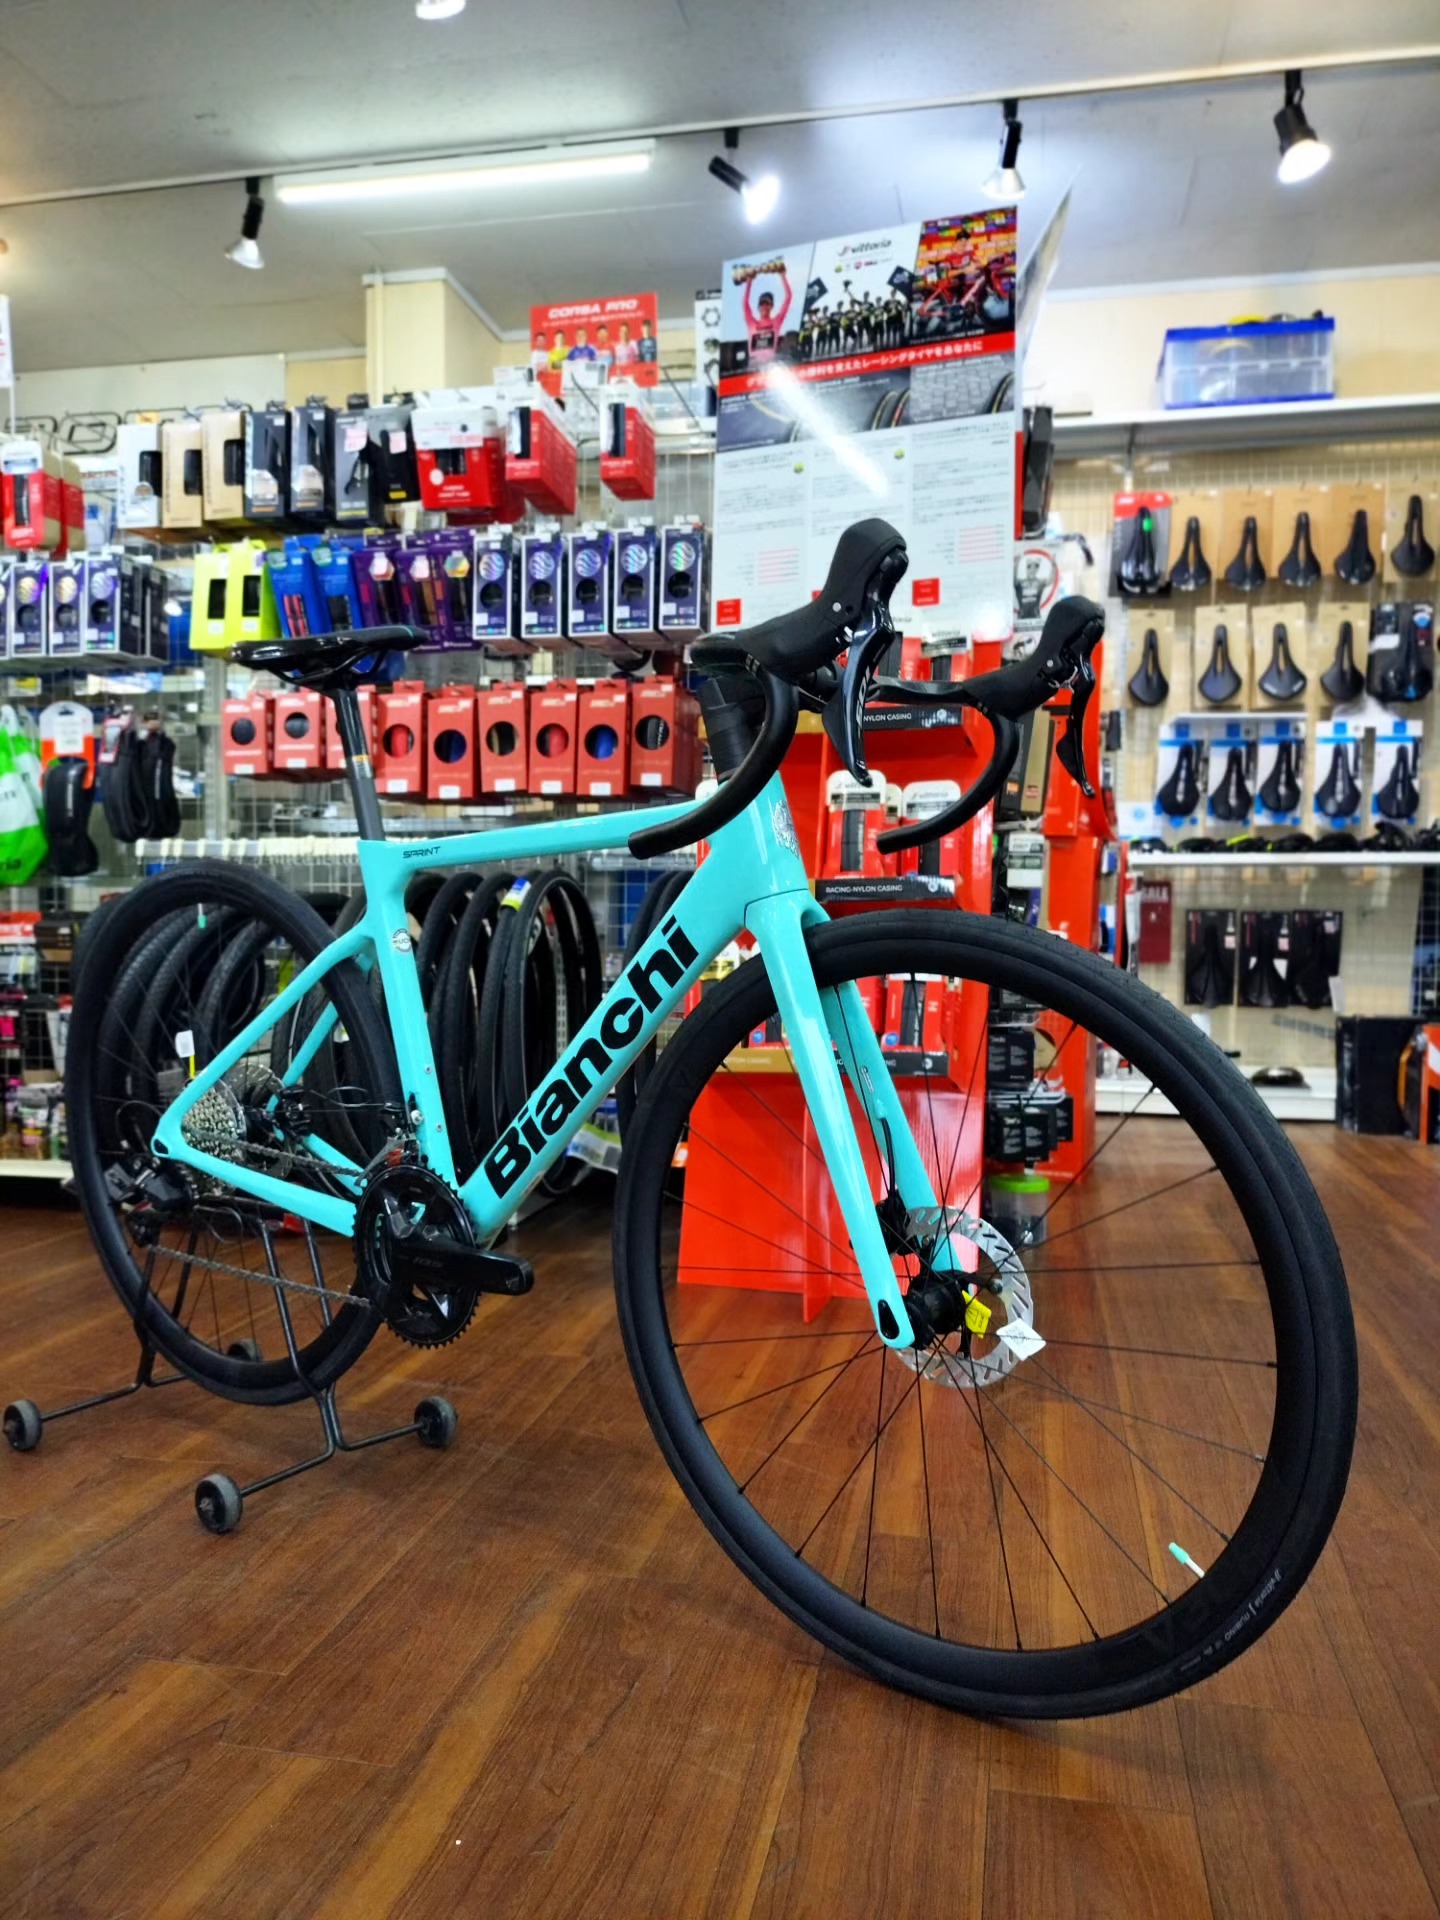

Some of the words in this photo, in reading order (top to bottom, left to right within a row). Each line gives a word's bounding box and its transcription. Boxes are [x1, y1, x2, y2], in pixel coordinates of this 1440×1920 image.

[887, 713, 912, 721] CASING
[403, 846, 441, 859] SPRINT
[825, 885, 877, 894] RACING-NYLON
[877, 884, 903, 892] CASING
[484, 914, 700, 1200] Bianchi
